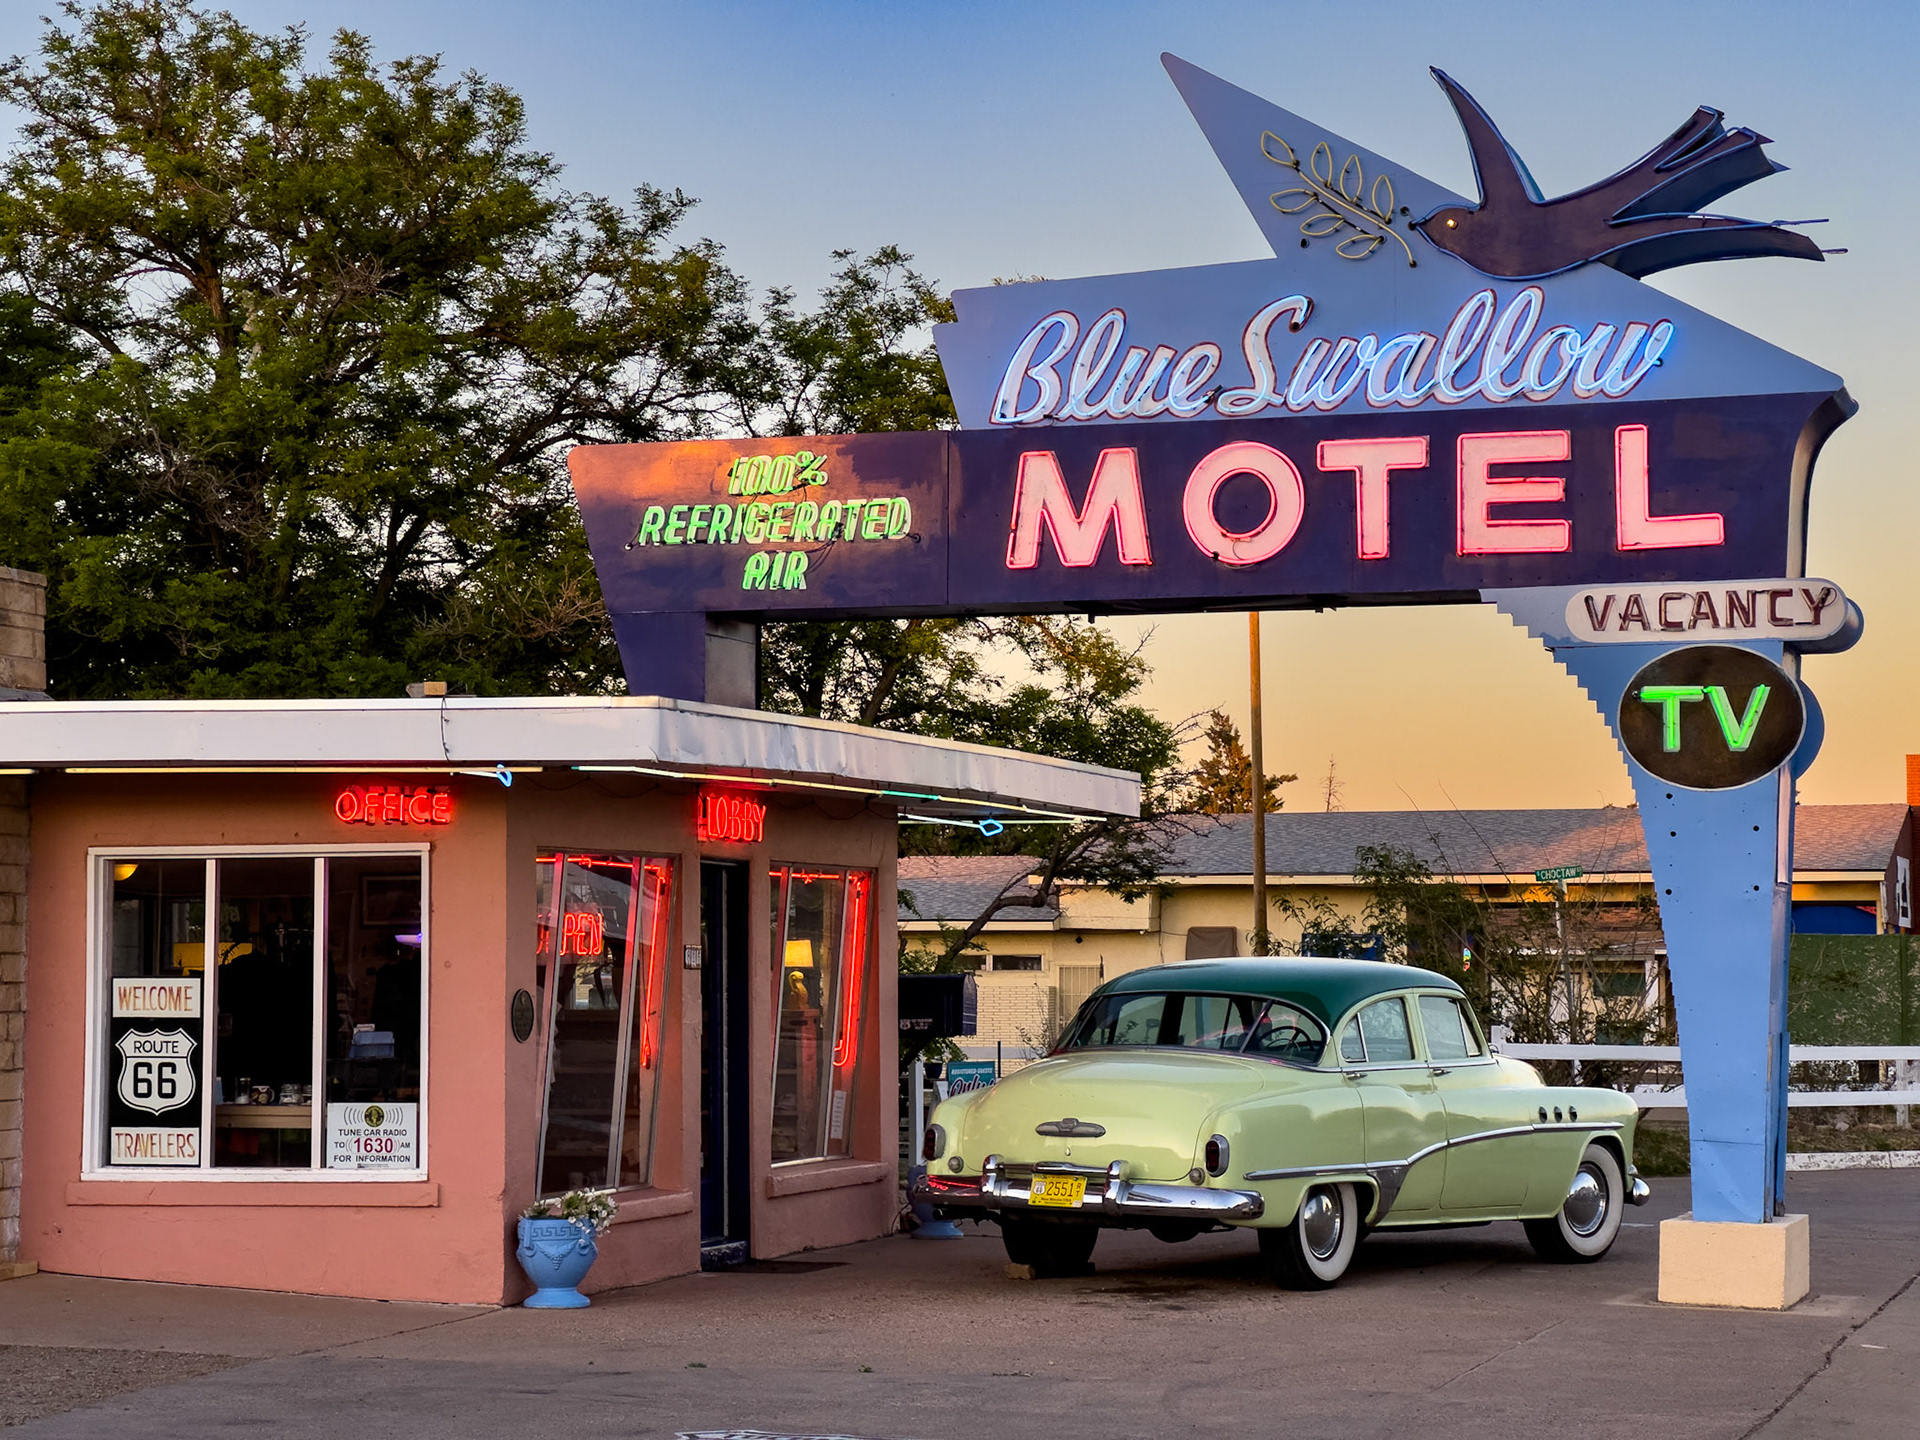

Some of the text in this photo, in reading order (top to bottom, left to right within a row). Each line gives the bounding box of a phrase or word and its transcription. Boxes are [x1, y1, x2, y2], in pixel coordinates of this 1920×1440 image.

[990, 285, 1673, 424] Blue Swallow
[728, 451, 828, 495] 100%
[1005, 423, 1725, 568] MOTEL
[639, 497, 912, 545] REFRIGERATED
[742, 551, 808, 590] AIR
[1584, 587, 1836, 631] VACANCY
[1640, 683, 1770, 751] TV
[335, 786, 452, 825] OFFICE
[698, 795, 767, 842] LOBBY
[1540, 868, 1576, 879] CHOCTAW
[556, 912, 604, 956] PEN
[118, 986, 193, 1012] WELCOME
[133, 1040, 179, 1054] ROUTE
[133, 1062, 176, 1099] 66
[115, 1133, 196, 1159] TRAVELERS
[334, 1141, 346, 1149] TO
[353, 1137, 394, 1153] 1630
[355, 1155, 411, 1163] INFORMATION
[1046, 1181, 1074, 1197] 2551
